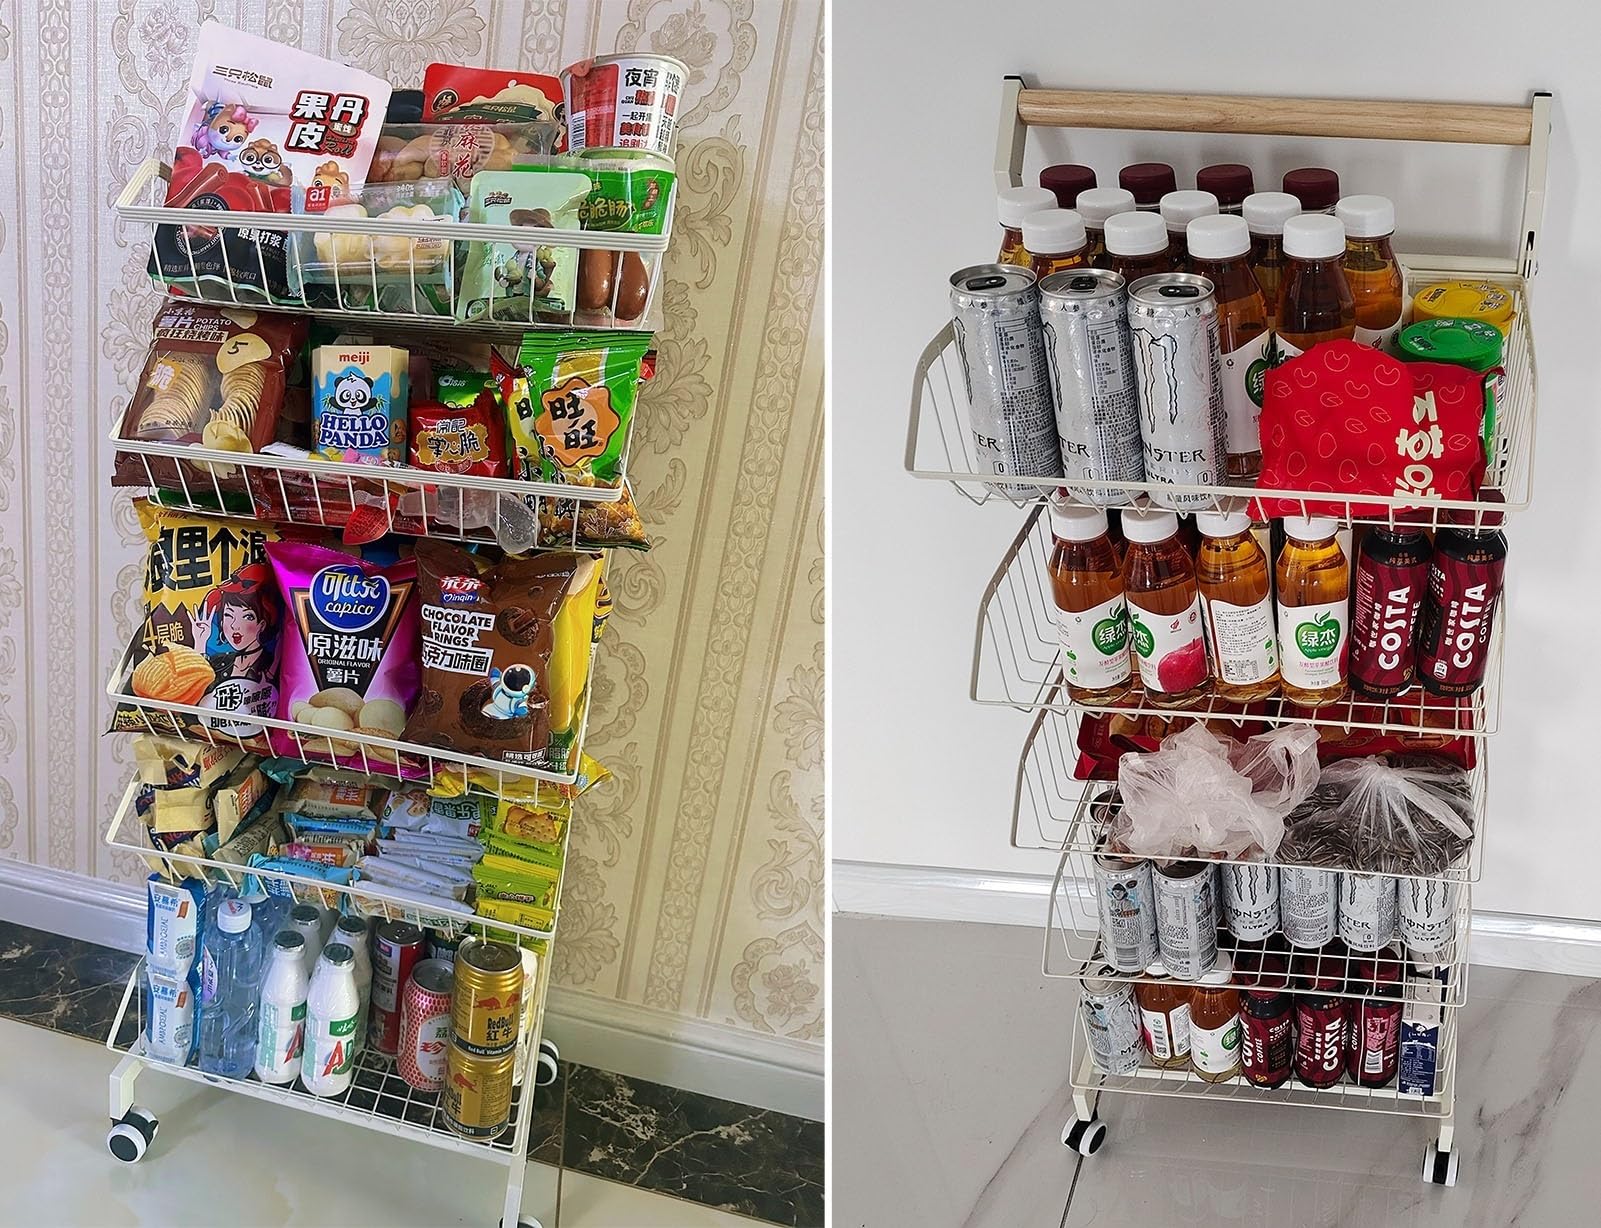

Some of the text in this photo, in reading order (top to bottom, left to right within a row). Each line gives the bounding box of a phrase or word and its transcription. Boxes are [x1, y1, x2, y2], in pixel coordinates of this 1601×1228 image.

[212, 65, 273, 89] 三只松鼠
[625, 68, 659, 88] 夜宵
[293, 92, 364, 124] 果丹
[288, 122, 326, 150] 皮
[193, 324, 220, 332] CHIPS
[195, 317, 232, 326] POTATO
[338, 352, 370, 365] meiji
[321, 413, 388, 432] HELLO
[549, 388, 600, 450] 旺旺
[319, 429, 390, 449] PANDA
[441, 575, 484, 592] 亲亲
[324, 600, 375, 618] copico
[422, 607, 492, 628] CHOCOLATE
[432, 620, 476, 638] FLAVOR
[1377, 585, 1412, 671] COSTA
[1452, 583, 1488, 669] COSTA
[1479, 597, 1494, 644] COFFEE
[433, 632, 470, 647] RINGS
[1099, 619, 1127, 646] 绿杰
[1134, 629, 1151, 650] 杰
[1301, 627, 1336, 648] 绿杰
[307, 632, 384, 662] 原滋味
[326, 668, 361, 686] 薯片
[217, 684, 241, 710] 咔
[486, 1026, 513, 1042] 红牛
[1322, 1016, 1343, 1071] COSTA
